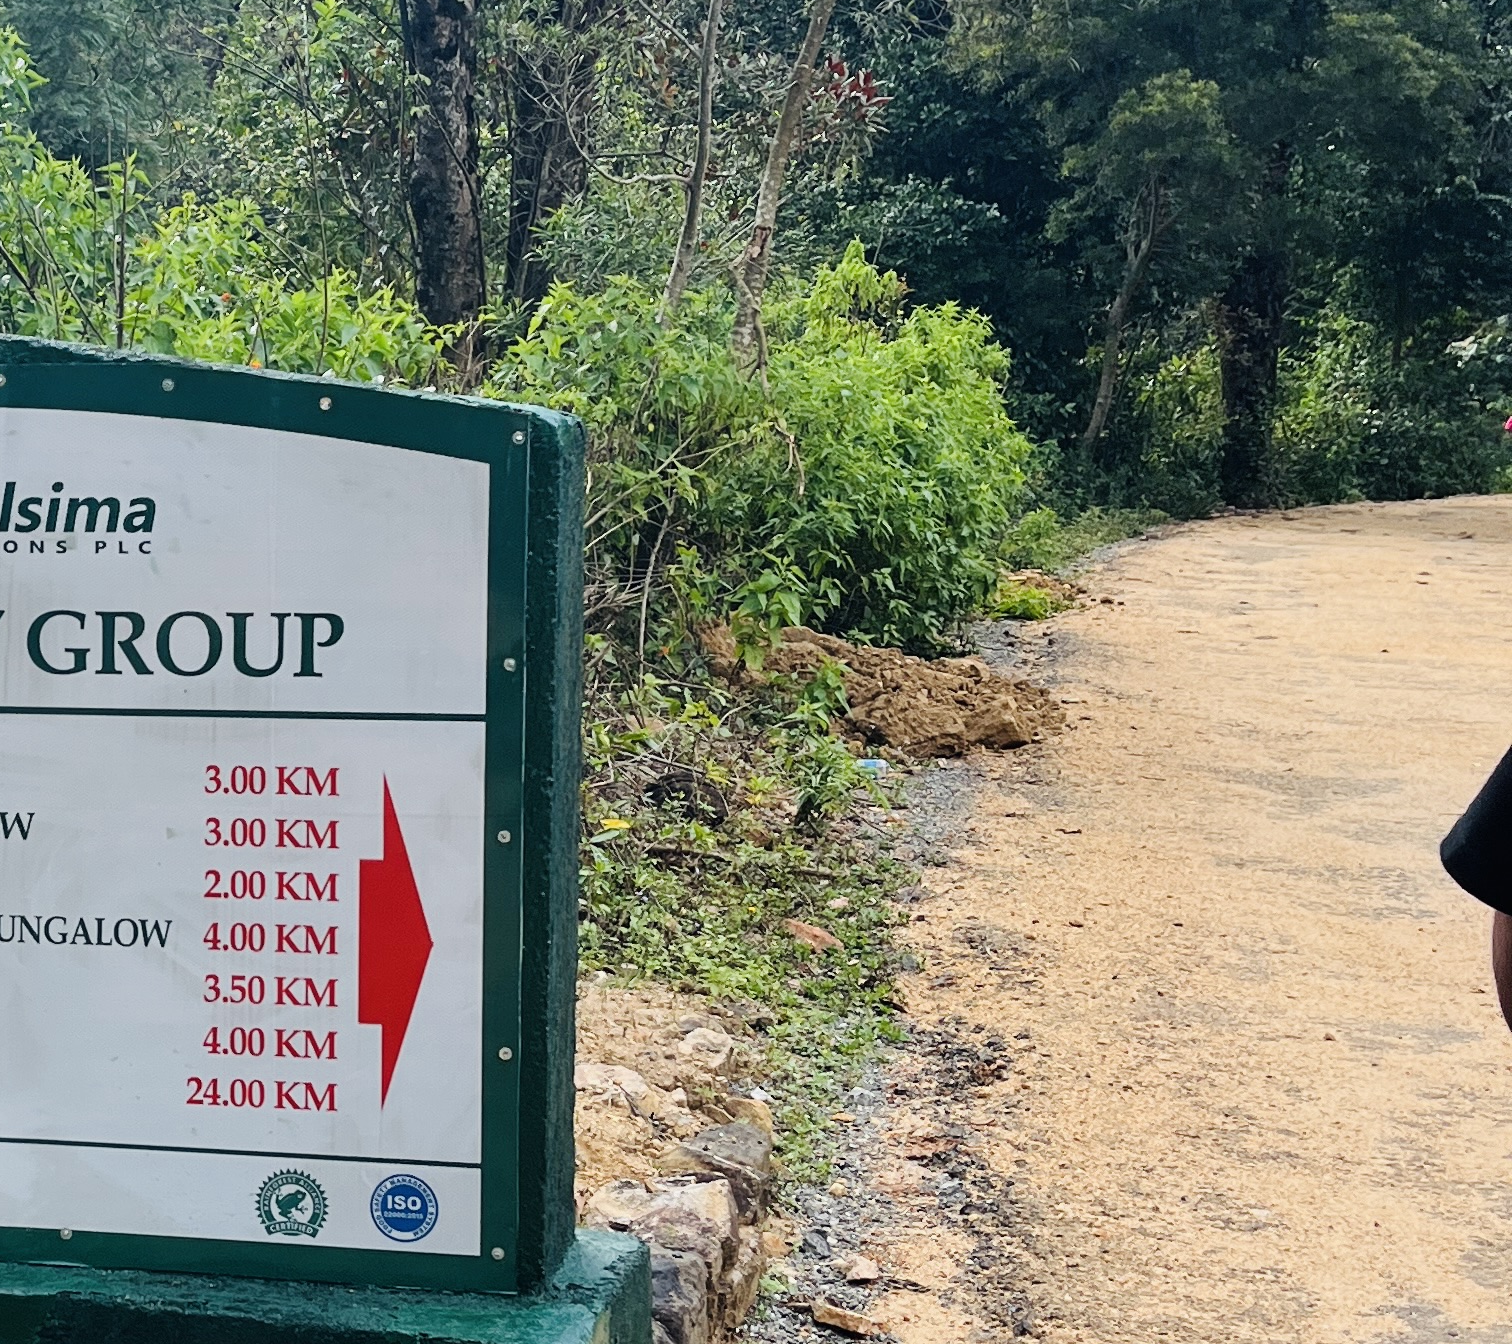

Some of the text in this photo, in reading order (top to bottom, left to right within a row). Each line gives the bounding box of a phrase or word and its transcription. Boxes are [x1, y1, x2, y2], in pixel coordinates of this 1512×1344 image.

[94, 539, 154, 555] PLC
[26, 609, 345, 678] GROUP
[204, 764, 340, 797] 3.00 KM
[204, 817, 340, 849] 3.00 KM
[203, 869, 339, 902] 2.00 KM
[203, 922, 339, 955] 4.00 KM
[203, 974, 338, 1007] 3.50 KM
[202, 1026, 338, 1059] 4.00 KM
[186, 1076, 338, 1111] 24.00 KM
[386, 1194, 422, 1211] ISO
